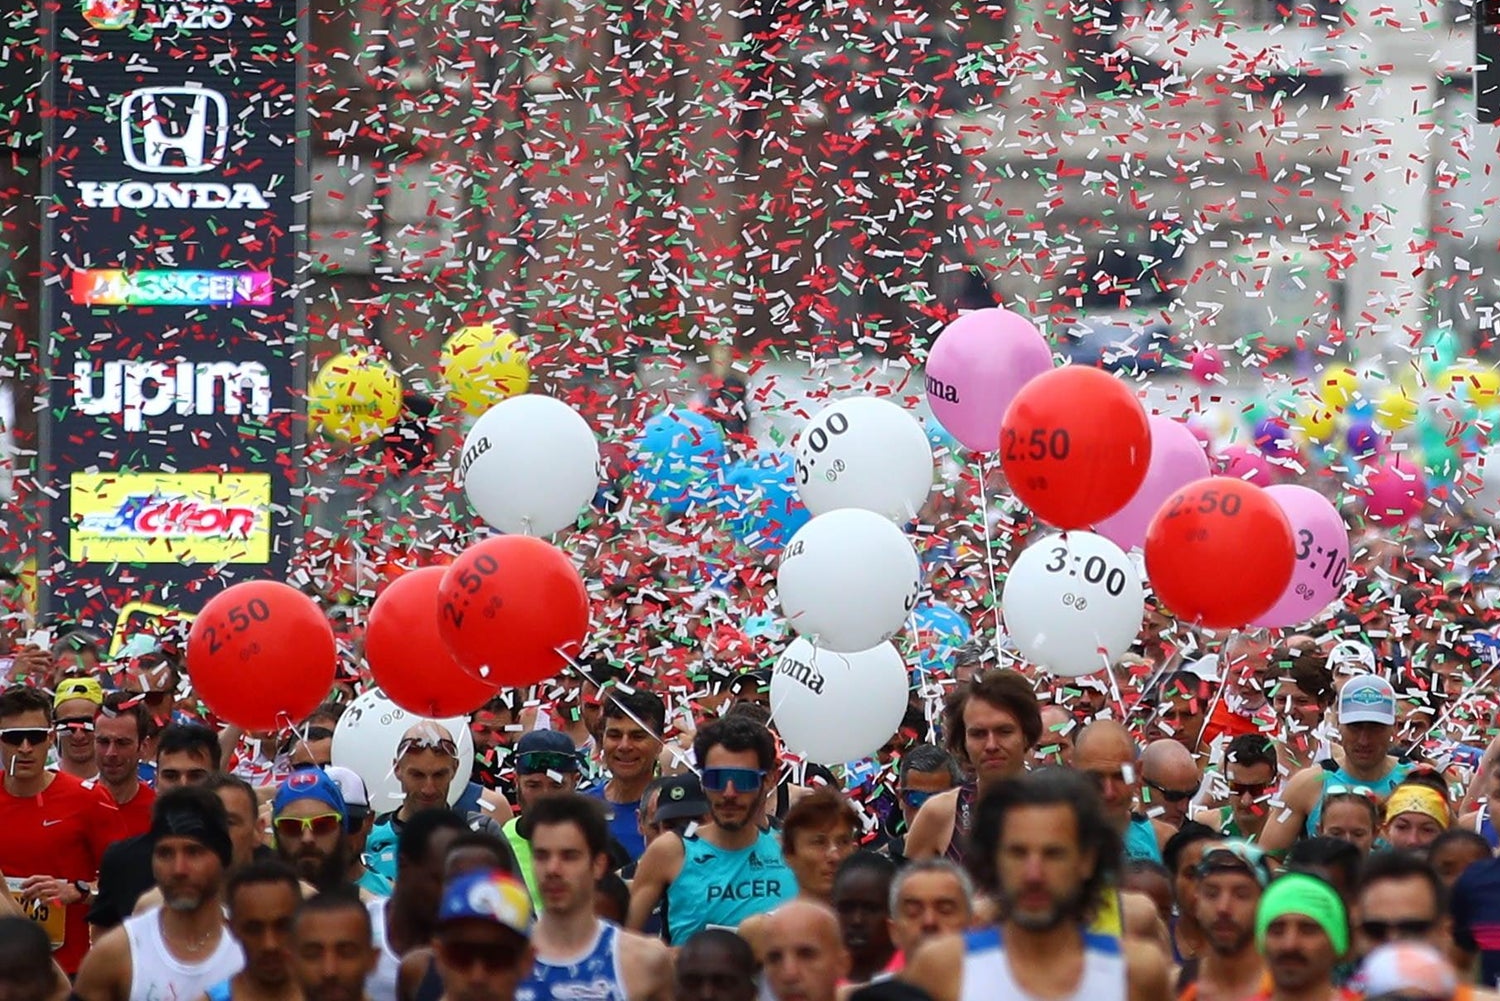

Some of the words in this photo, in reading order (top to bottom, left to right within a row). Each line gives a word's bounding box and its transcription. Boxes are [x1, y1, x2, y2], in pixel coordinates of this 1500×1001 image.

[143, 5, 233, 30] LAZIO
[77, 181, 270, 209] HONDA
[73, 361, 271, 432] upim
[794, 411, 849, 485] 3:00
[1005, 428, 1070, 462] 2:50
[1166, 489, 1242, 519] 2:50
[1044, 546, 1127, 598] 3:00
[1295, 528, 1349, 590] 3:10
[442, 554, 499, 630] 2:50
[201, 597, 271, 656] 2:50
[774, 656, 826, 696] joma
[706, 878, 782, 902] PACER
